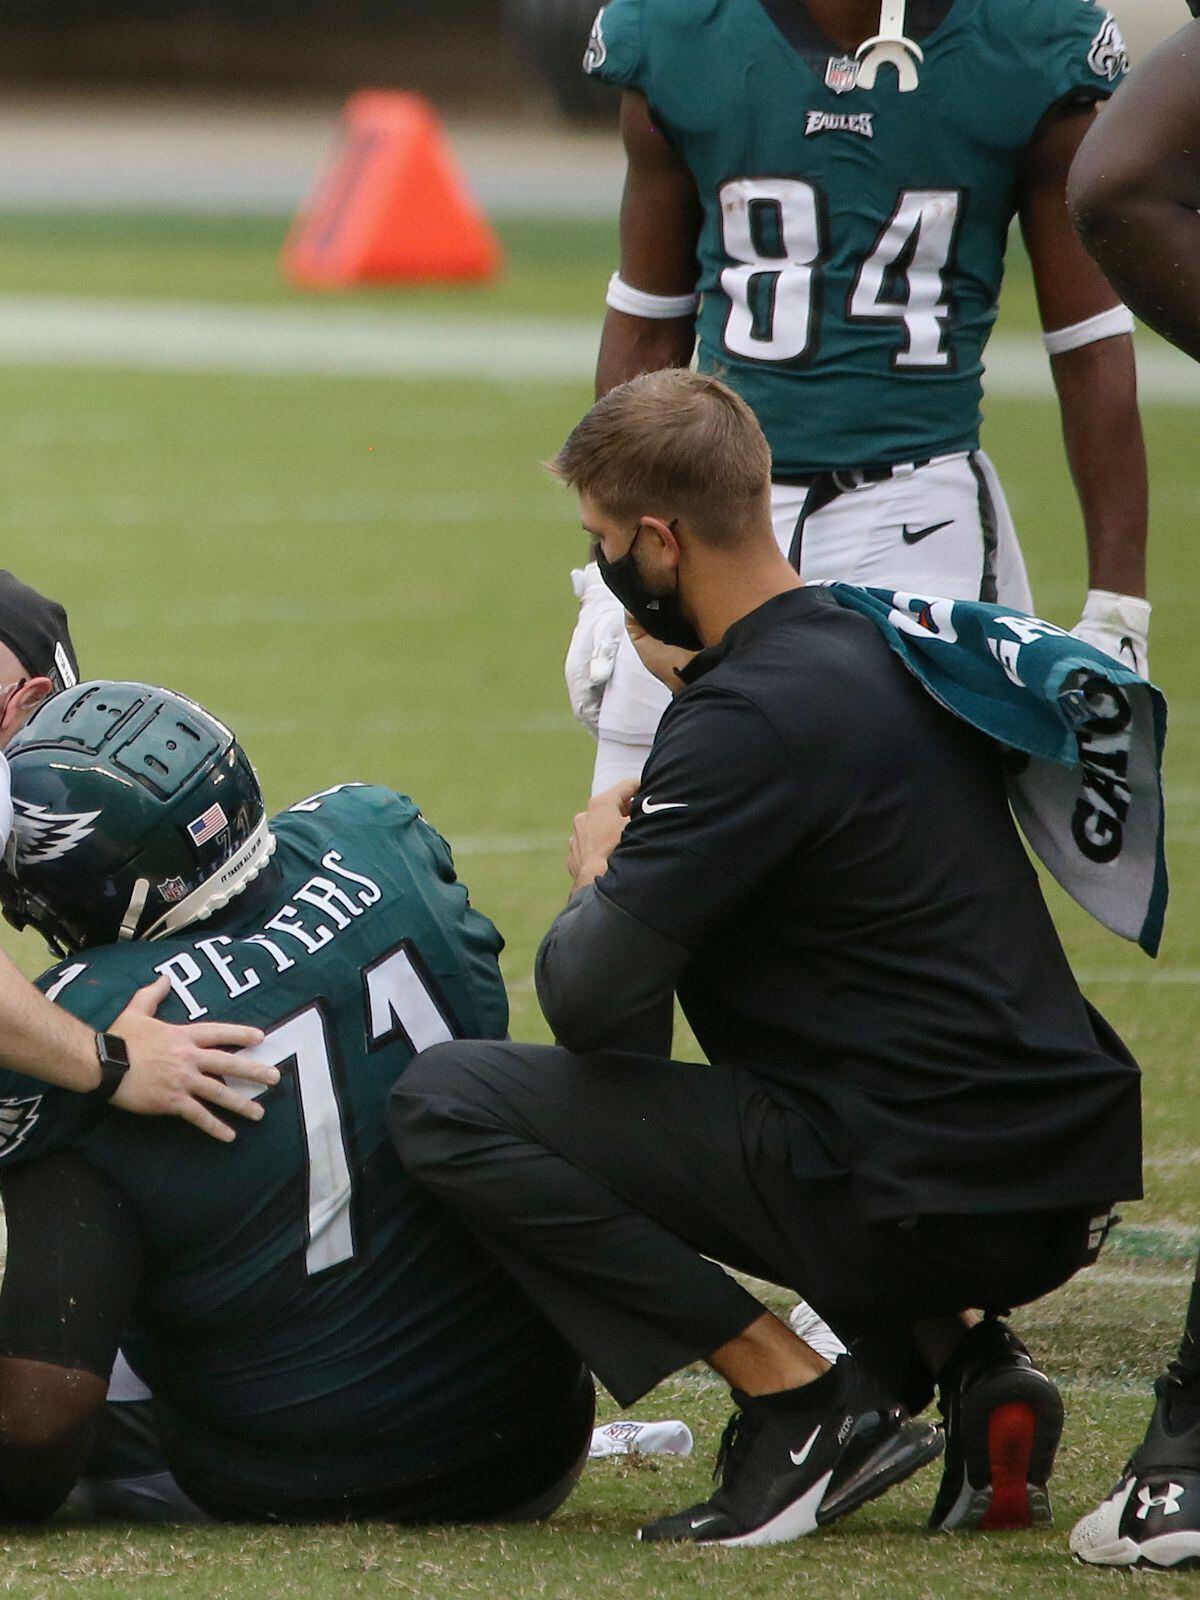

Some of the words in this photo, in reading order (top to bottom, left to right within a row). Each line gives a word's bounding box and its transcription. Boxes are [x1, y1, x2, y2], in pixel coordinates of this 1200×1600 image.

[805, 110, 875, 138] EAGLES
[719, 178, 960, 367] 84
[153, 849, 382, 1021] PETERS
[166, 885, 185, 899] NFL
